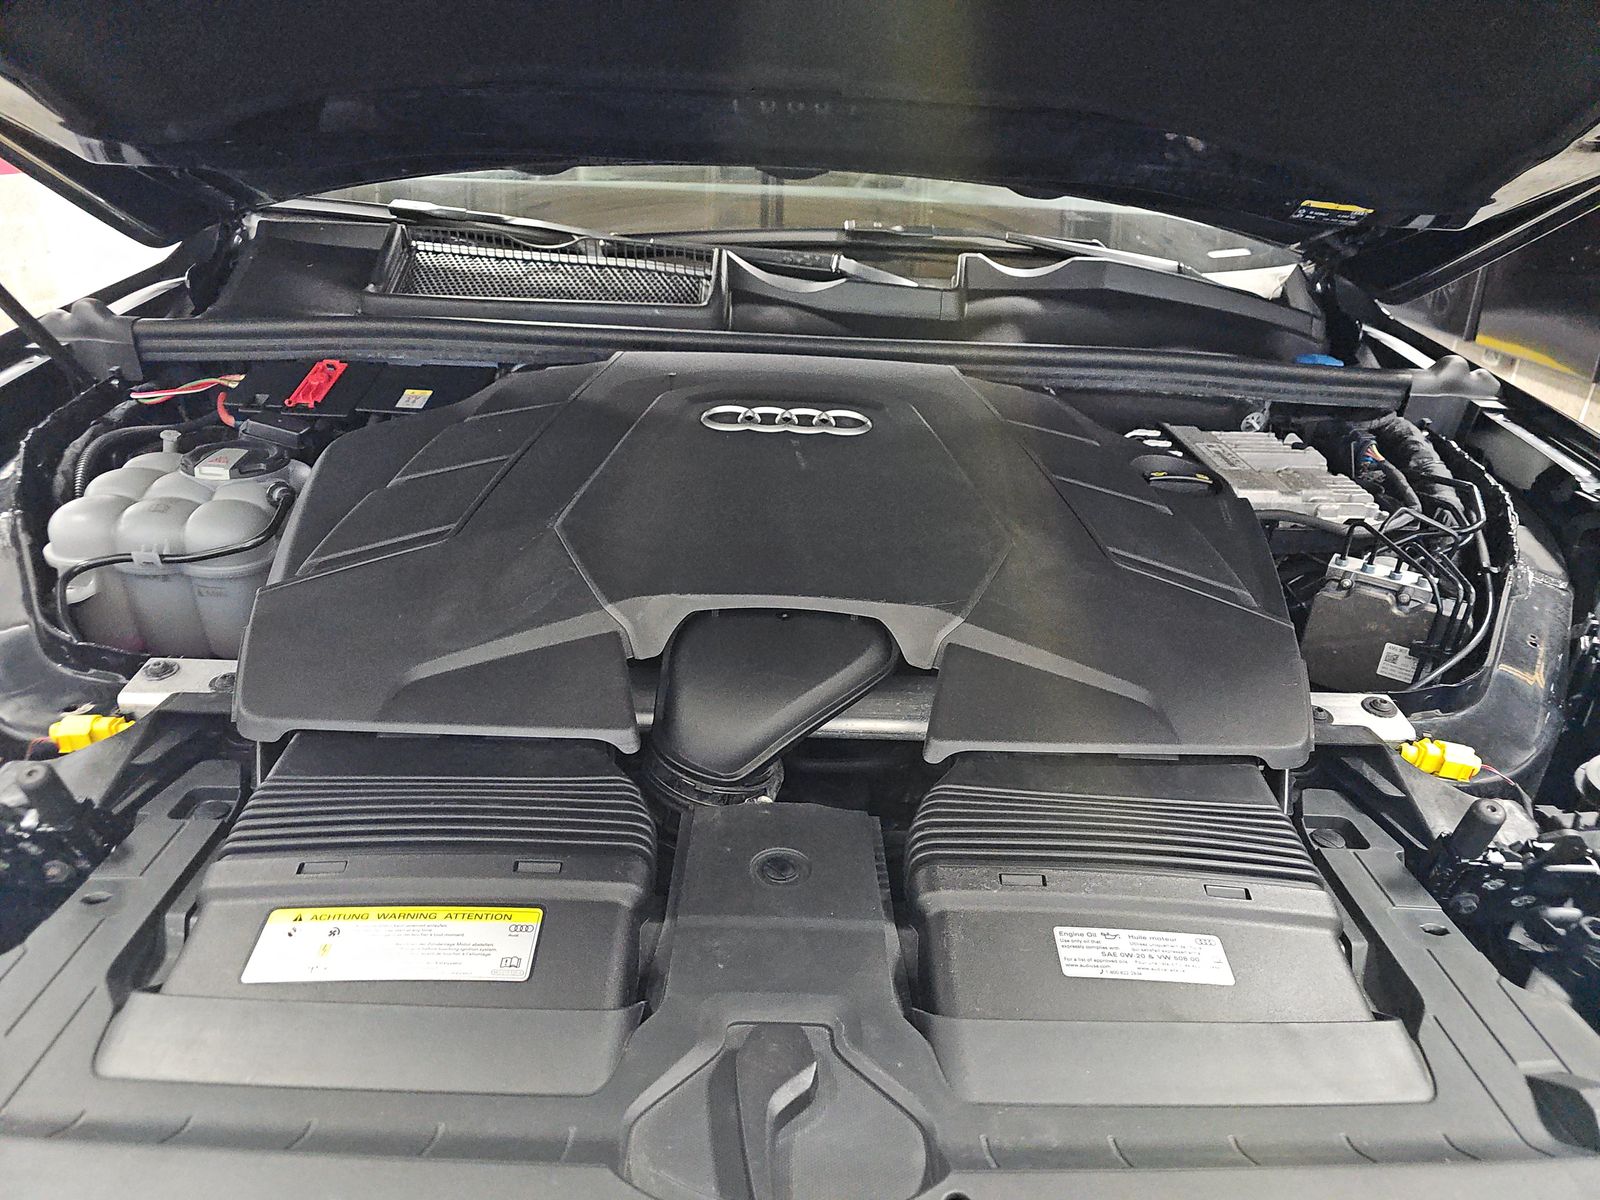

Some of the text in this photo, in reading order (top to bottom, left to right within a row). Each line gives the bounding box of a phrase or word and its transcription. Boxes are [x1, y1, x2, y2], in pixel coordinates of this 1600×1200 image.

[310, 912, 513, 921] ACHTUNG WARNING ATTENTION
